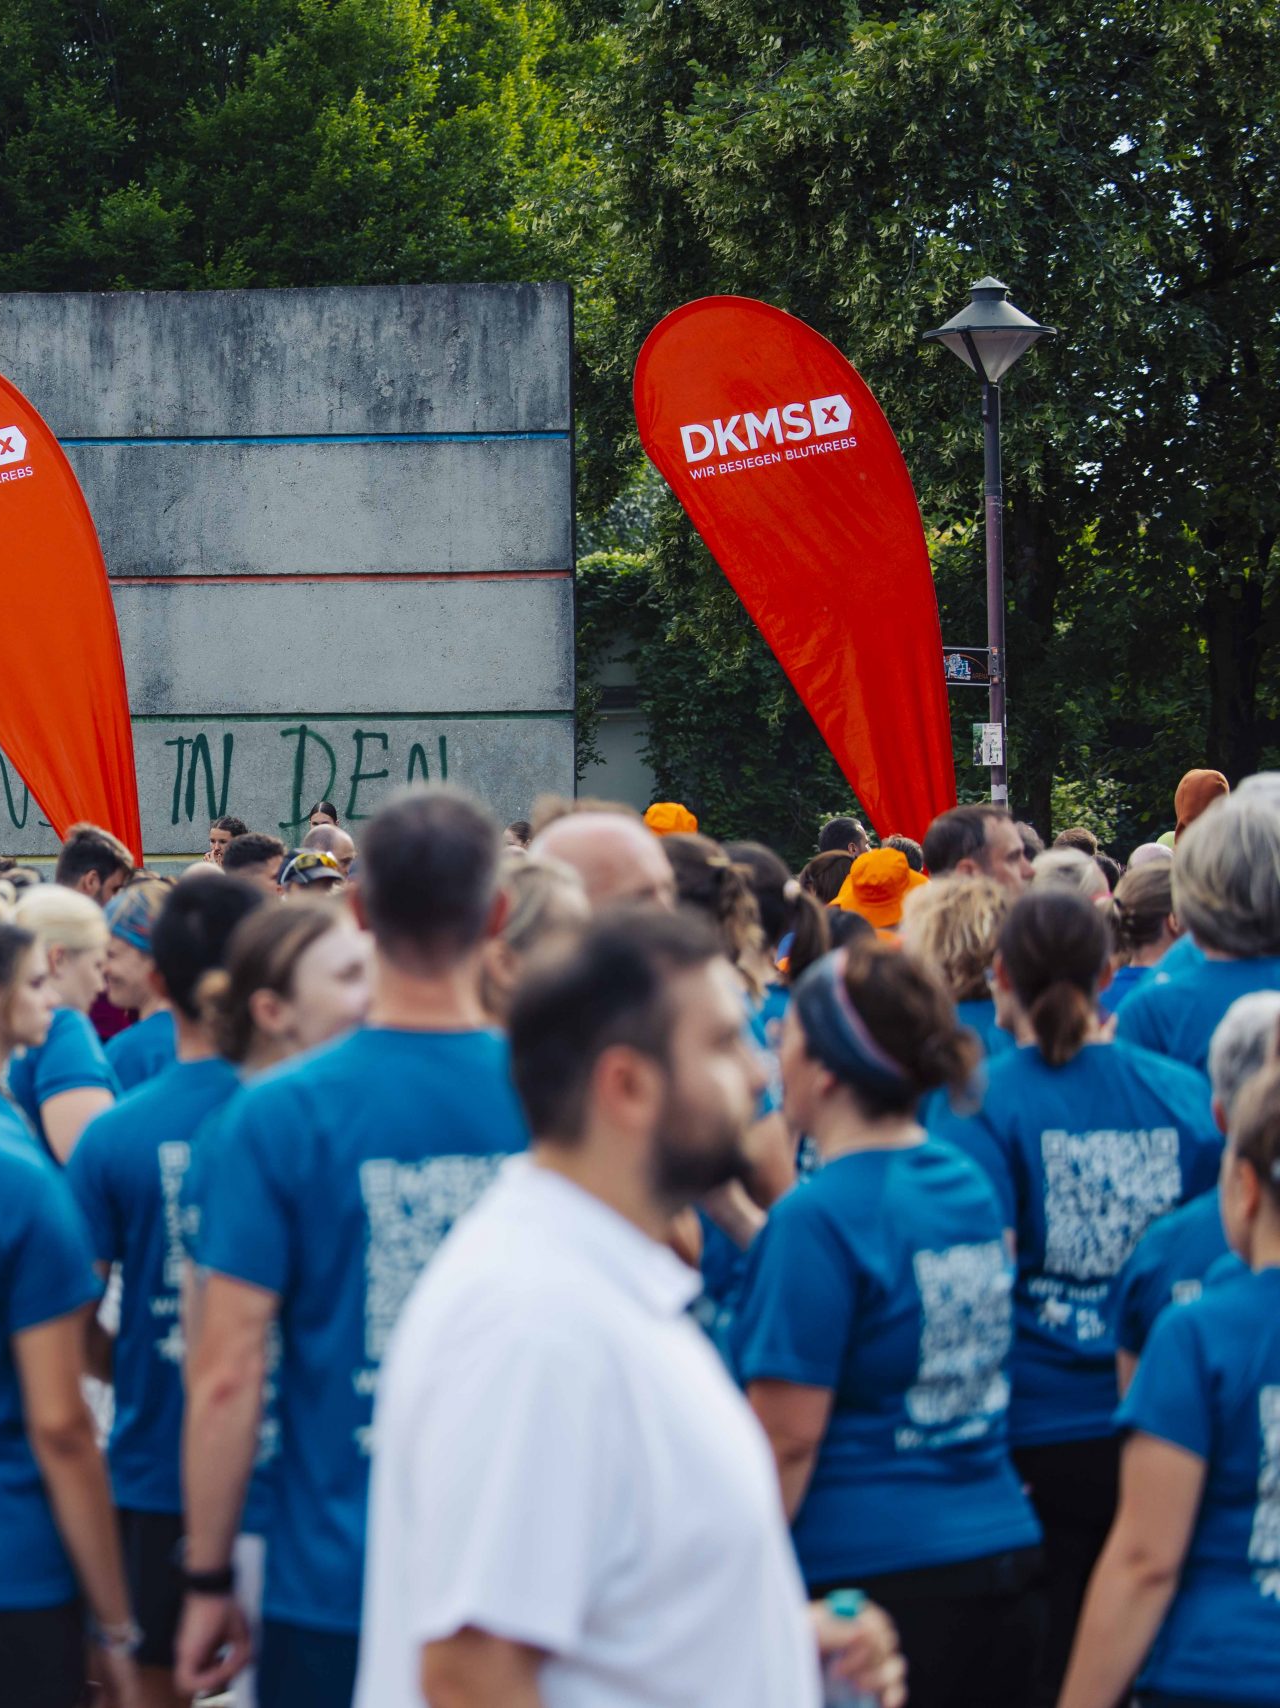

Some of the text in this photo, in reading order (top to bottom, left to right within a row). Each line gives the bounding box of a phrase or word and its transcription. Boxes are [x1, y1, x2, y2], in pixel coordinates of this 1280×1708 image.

[680, 403, 812, 463] DKMS
[689, 437, 857, 480] WIR BESIEGEN BLUTKREBS
[165, 733, 234, 826] IN
